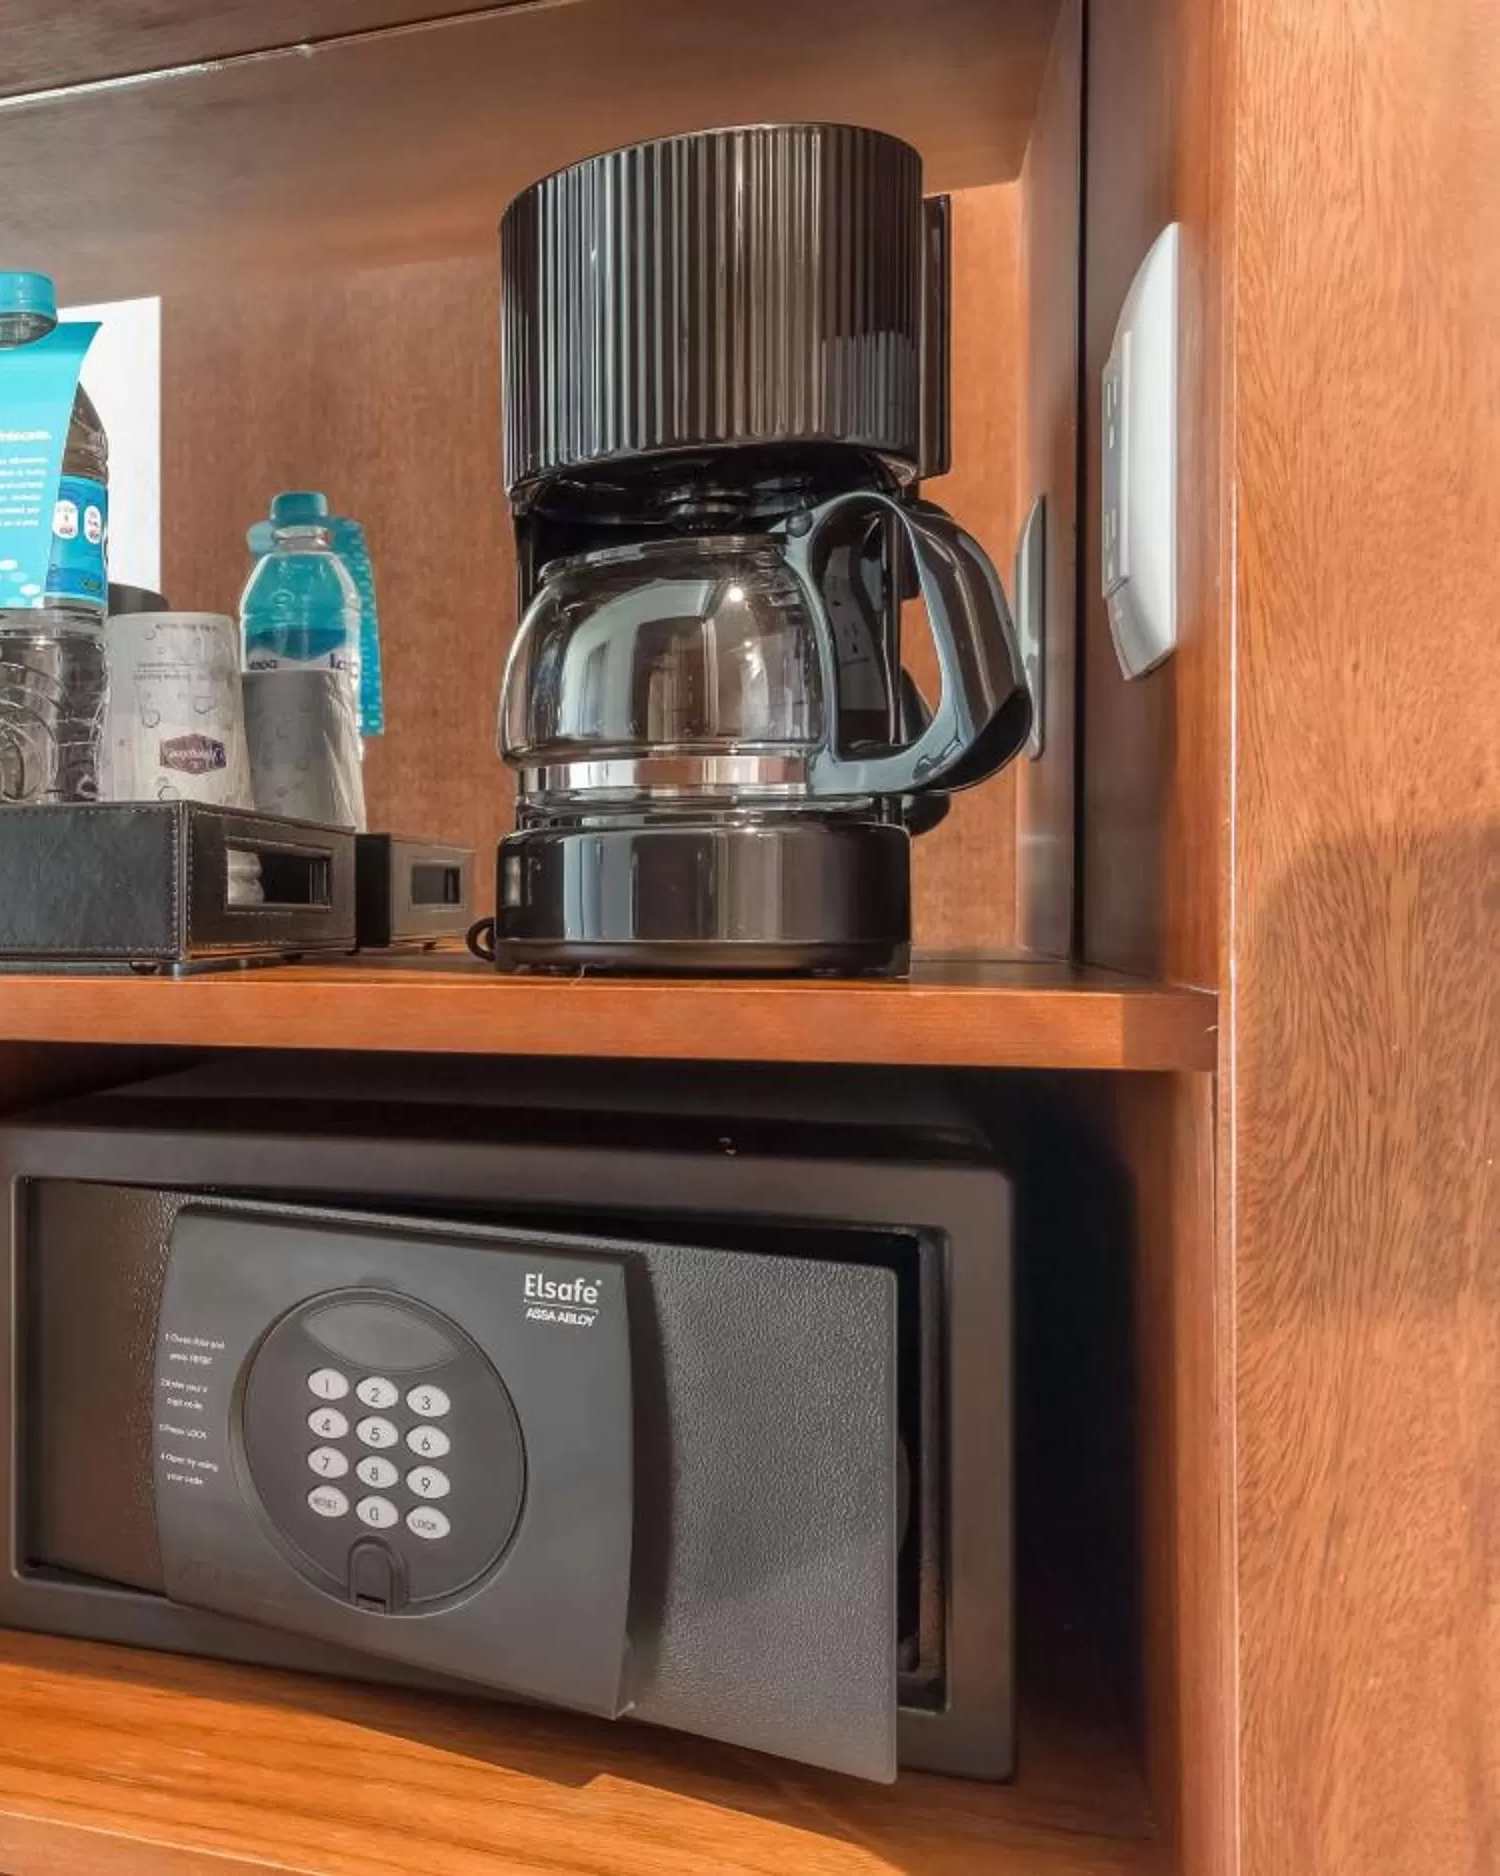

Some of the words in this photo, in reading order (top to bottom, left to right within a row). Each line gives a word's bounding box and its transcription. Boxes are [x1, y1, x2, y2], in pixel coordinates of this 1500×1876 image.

[526, 1307, 556, 1321] ASSA
[557, 1311, 595, 1327] ABLOY
[370, 1387, 380, 1403] 2
[421, 1395, 431, 1411] 3
[321, 1417, 331, 1432] 4
[369, 1427, 380, 1442] 5
[421, 1436, 431, 1451] 6
[321, 1455, 331, 1471] 7
[369, 1466, 379, 1482] 8
[421, 1476, 431, 1492] 9
[369, 1506, 379, 1521] 0
